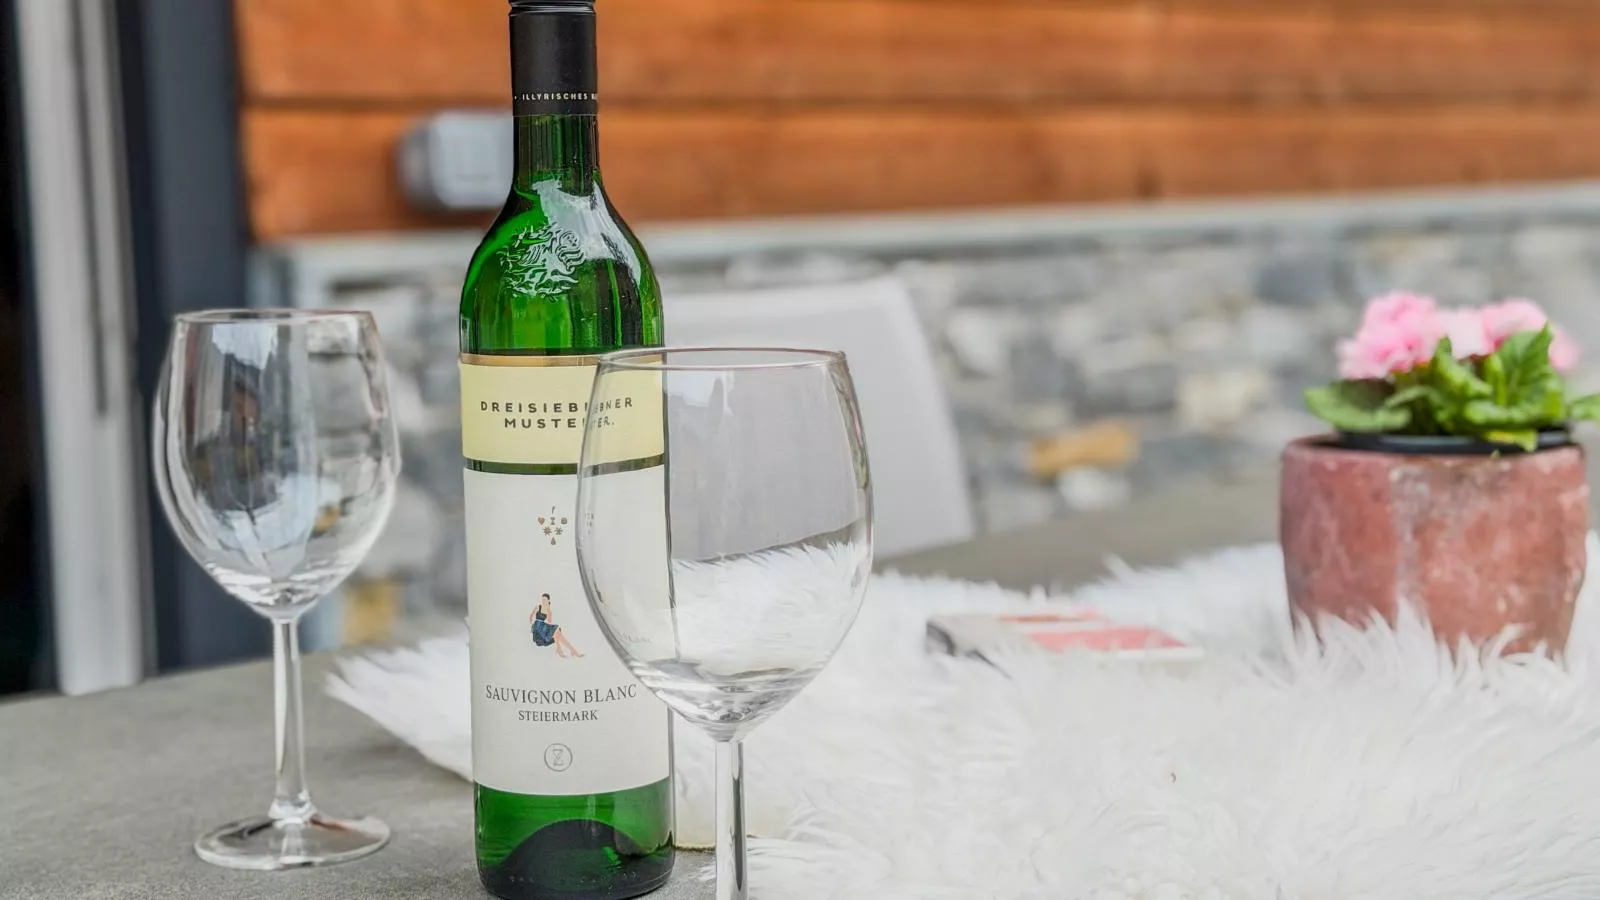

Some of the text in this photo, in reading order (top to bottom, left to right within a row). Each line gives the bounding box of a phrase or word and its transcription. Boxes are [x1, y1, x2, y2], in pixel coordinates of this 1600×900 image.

[522, 93, 588, 101] ILLYRISCHES
[486, 684, 637, 705] SAUVIGNON BLANC
[518, 710, 599, 722] STEIERMARK
